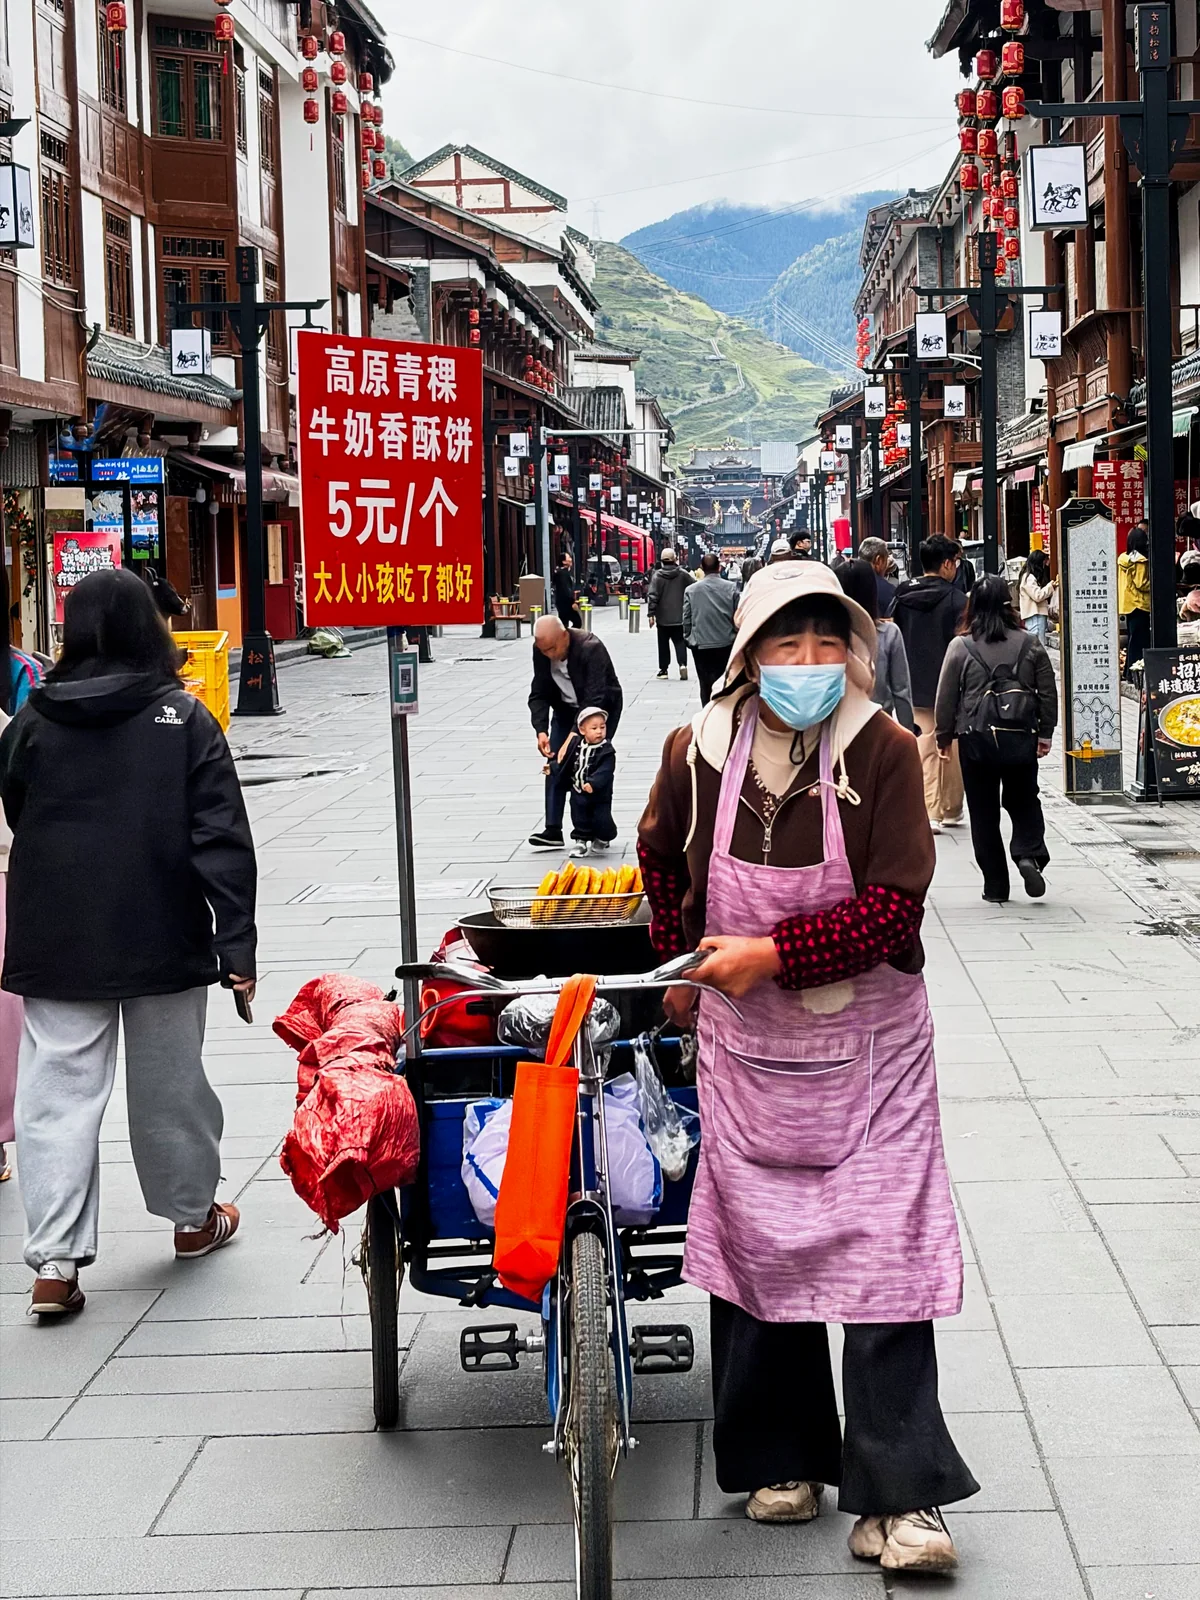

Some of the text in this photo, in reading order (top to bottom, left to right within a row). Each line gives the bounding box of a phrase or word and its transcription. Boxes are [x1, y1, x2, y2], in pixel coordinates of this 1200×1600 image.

[325, 345, 457, 403] 高原青稞
[309, 406, 473, 464] 牛奶香酥饼
[1094, 462, 1142, 480] 早餐
[1095, 482, 1143, 490] 稀饭 豆浆
[328, 477, 459, 547] 5元/个
[1095, 491, 1143, 499] 油条 包子
[313, 561, 473, 604] 大人小孩吃了都好
[247, 649, 264, 690] 松州
[154, 716, 184, 725] CAMEL
